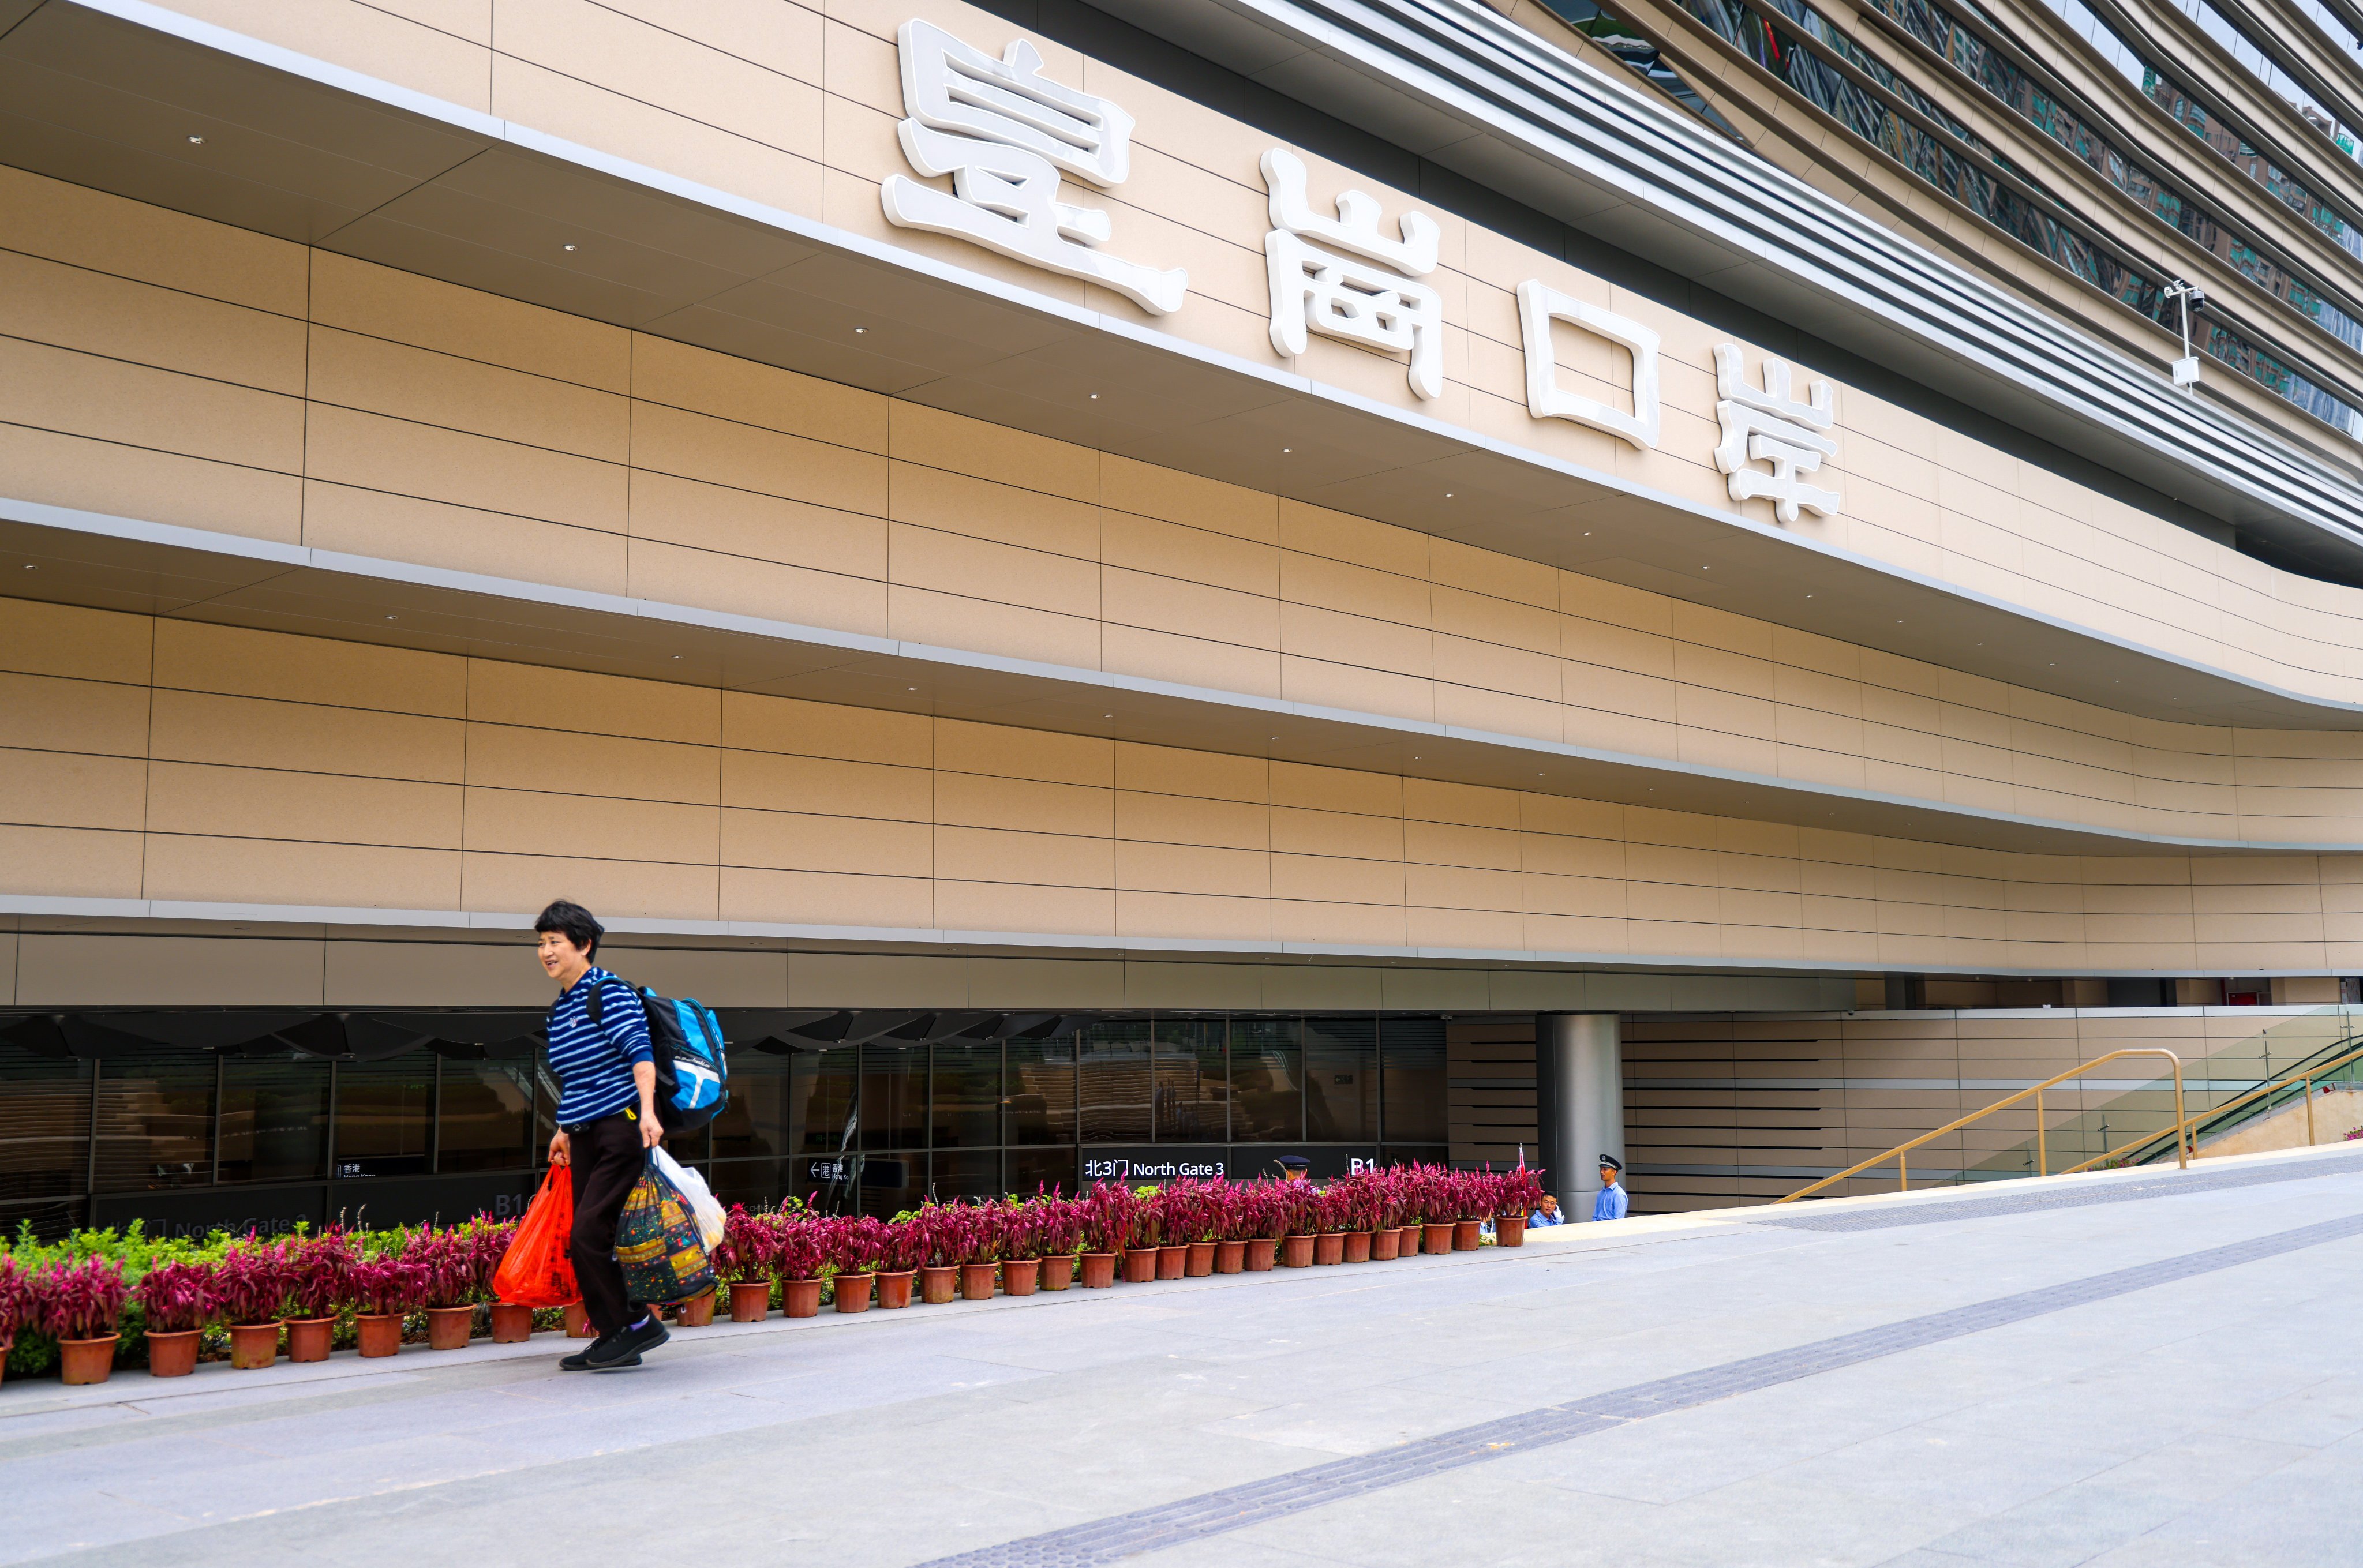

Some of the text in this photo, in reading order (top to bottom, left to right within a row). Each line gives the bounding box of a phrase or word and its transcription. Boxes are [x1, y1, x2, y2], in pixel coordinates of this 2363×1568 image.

[344, 1163, 361, 1173] 香港
[1134, 1162, 1175, 1176] North
[1179, 1162, 1213, 1176] Gate
[1215, 1162, 1224, 1176] 3
[1351, 1158, 1375, 1176] B1
[495, 1193, 522, 1216] B1
[242, 1217, 290, 1234] Gate
